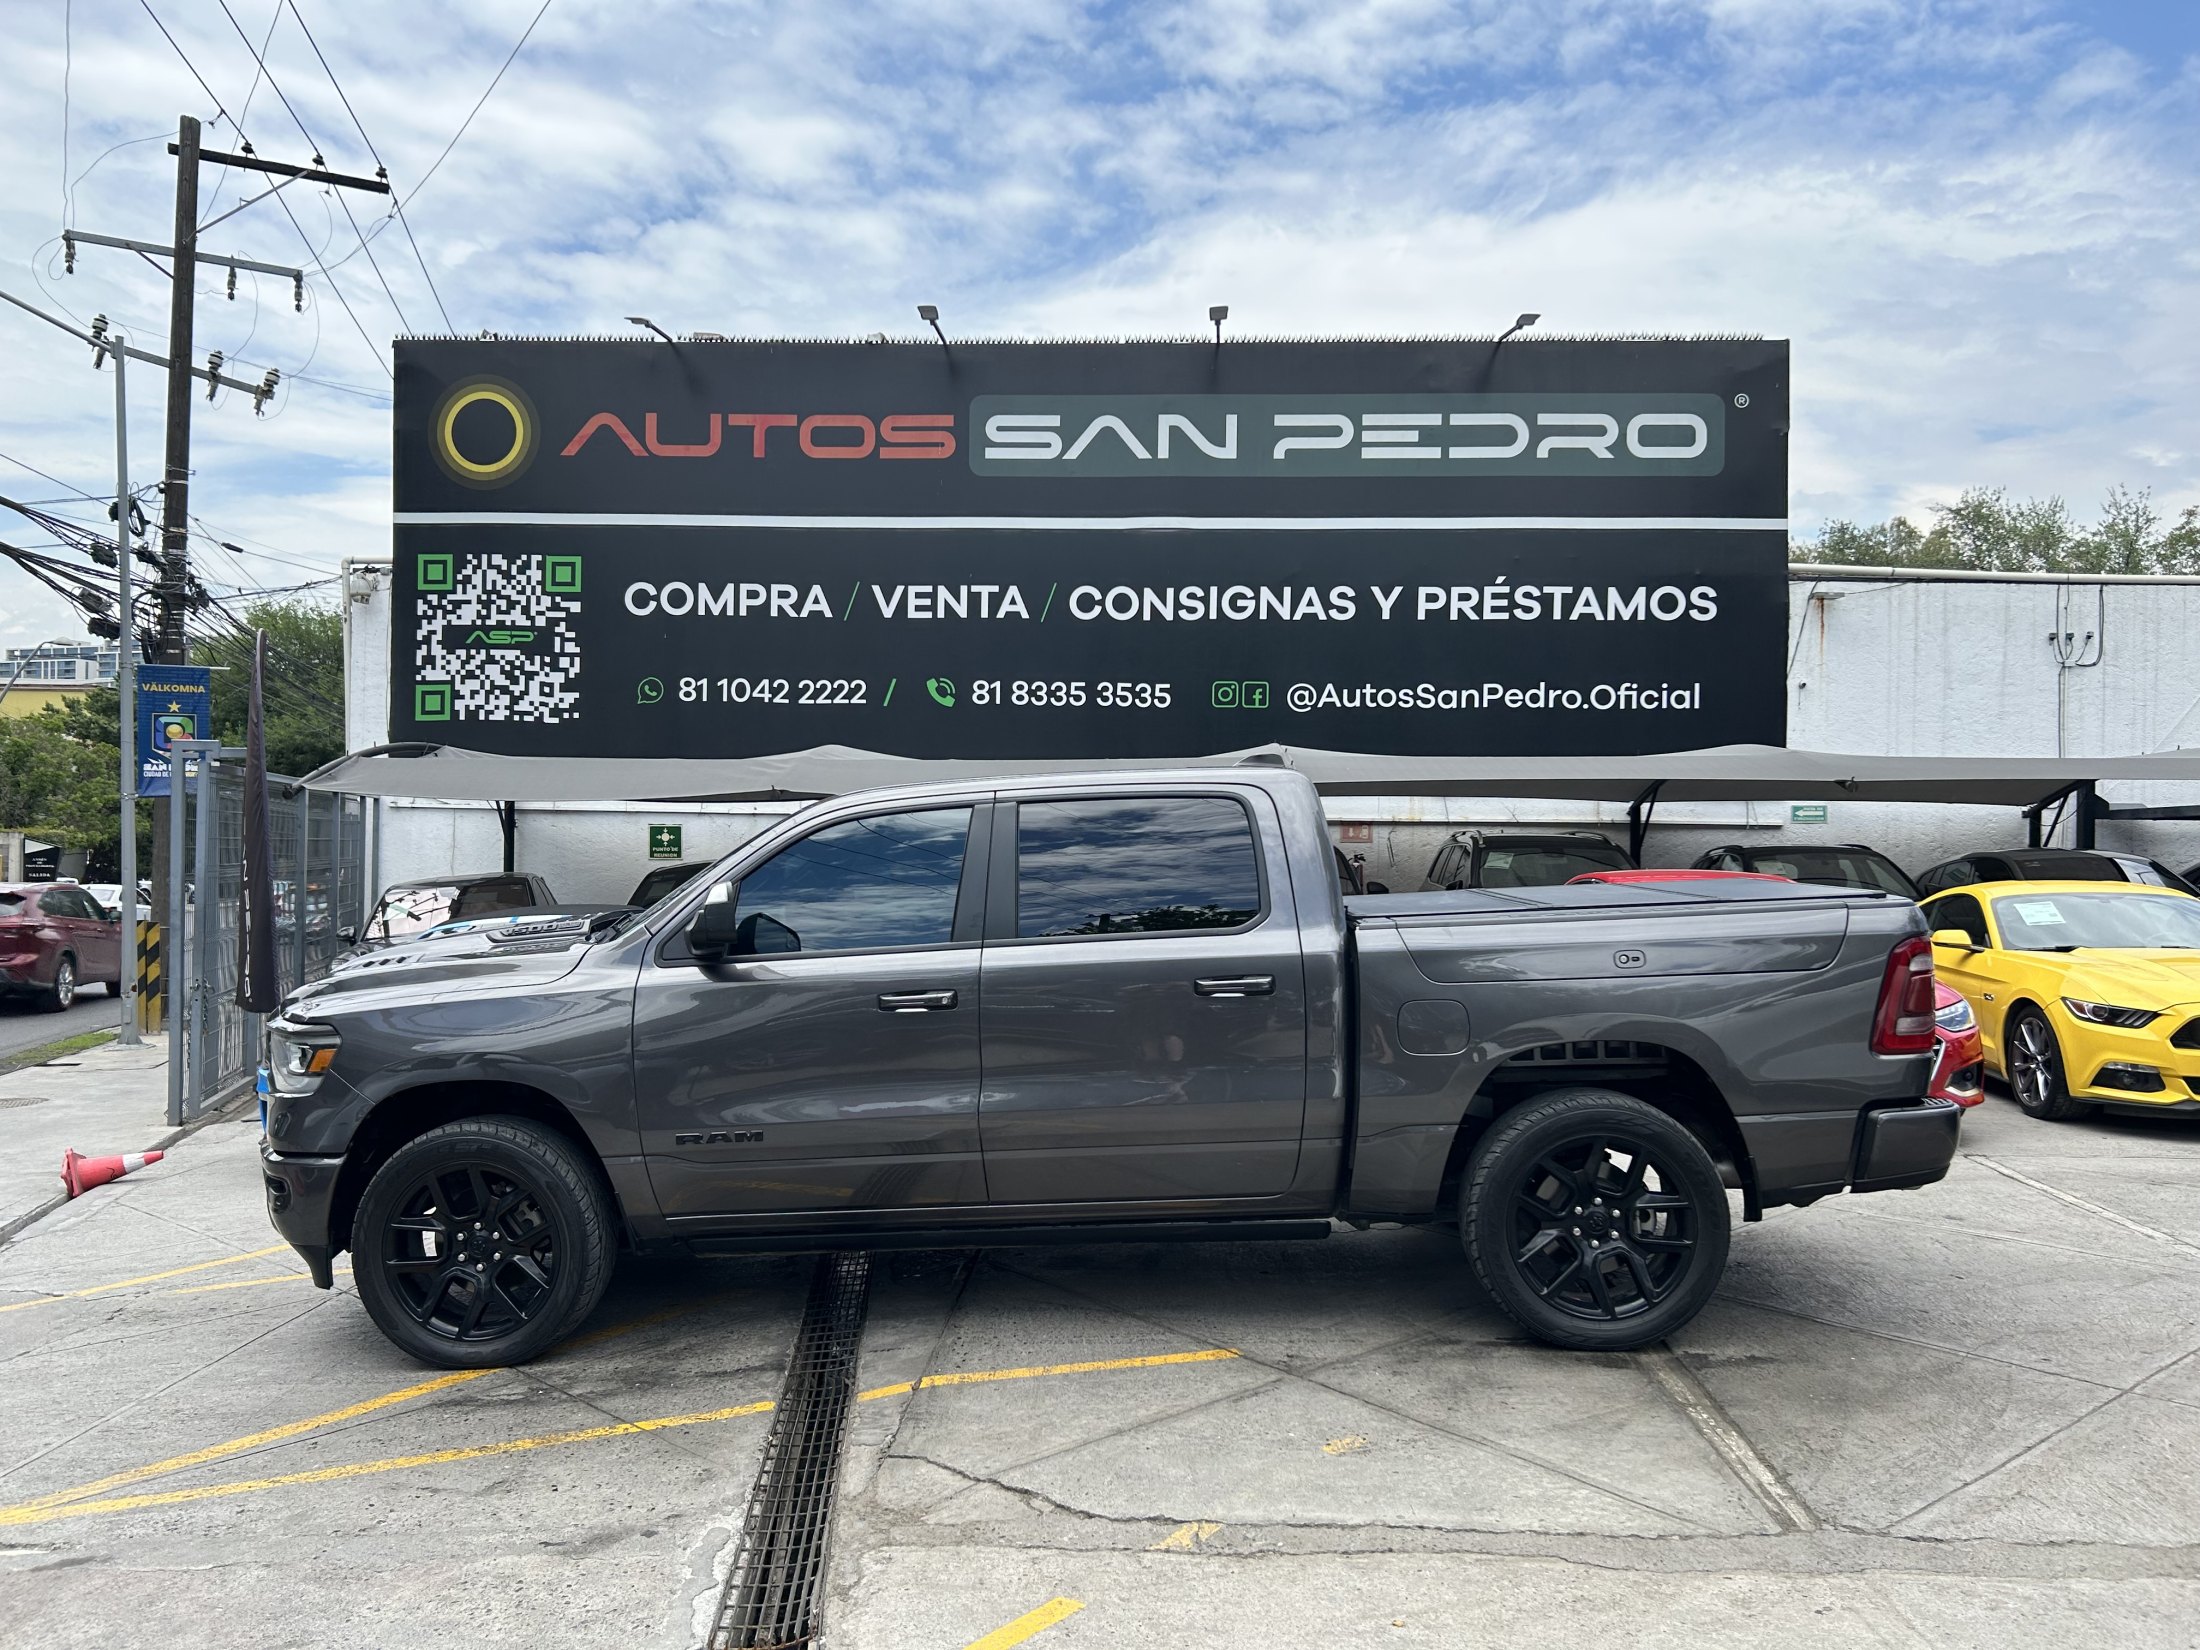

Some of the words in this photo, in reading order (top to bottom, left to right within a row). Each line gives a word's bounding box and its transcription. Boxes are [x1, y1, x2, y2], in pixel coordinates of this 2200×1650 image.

[561, 412, 957, 460] AUTOS
[984, 414, 1238, 460] SAN
[1273, 413, 1708, 460] PEDRO
[624, 581, 834, 618] COMPRA
[872, 584, 1030, 619] VENTA
[1068, 585, 1357, 621] CONSIGNAS
[1371, 585, 1404, 620] Y
[1417, 575, 1718, 622] PRÉSTAMOS
[465, 630, 534, 644] ASP
[142, 682, 206, 693] VÄLKOMNA
[678, 677, 708, 702] 81
[717, 677, 790, 704] 1042
[797, 679, 867, 705] 2222
[972, 679, 1001, 705] 81
[1011, 680, 1087, 707] 8335
[1096, 682, 1172, 708] 3535
[1286, 681, 1701, 714] @AutosSanPedro.Oficial
[675, 1130, 764, 1146] RAM
